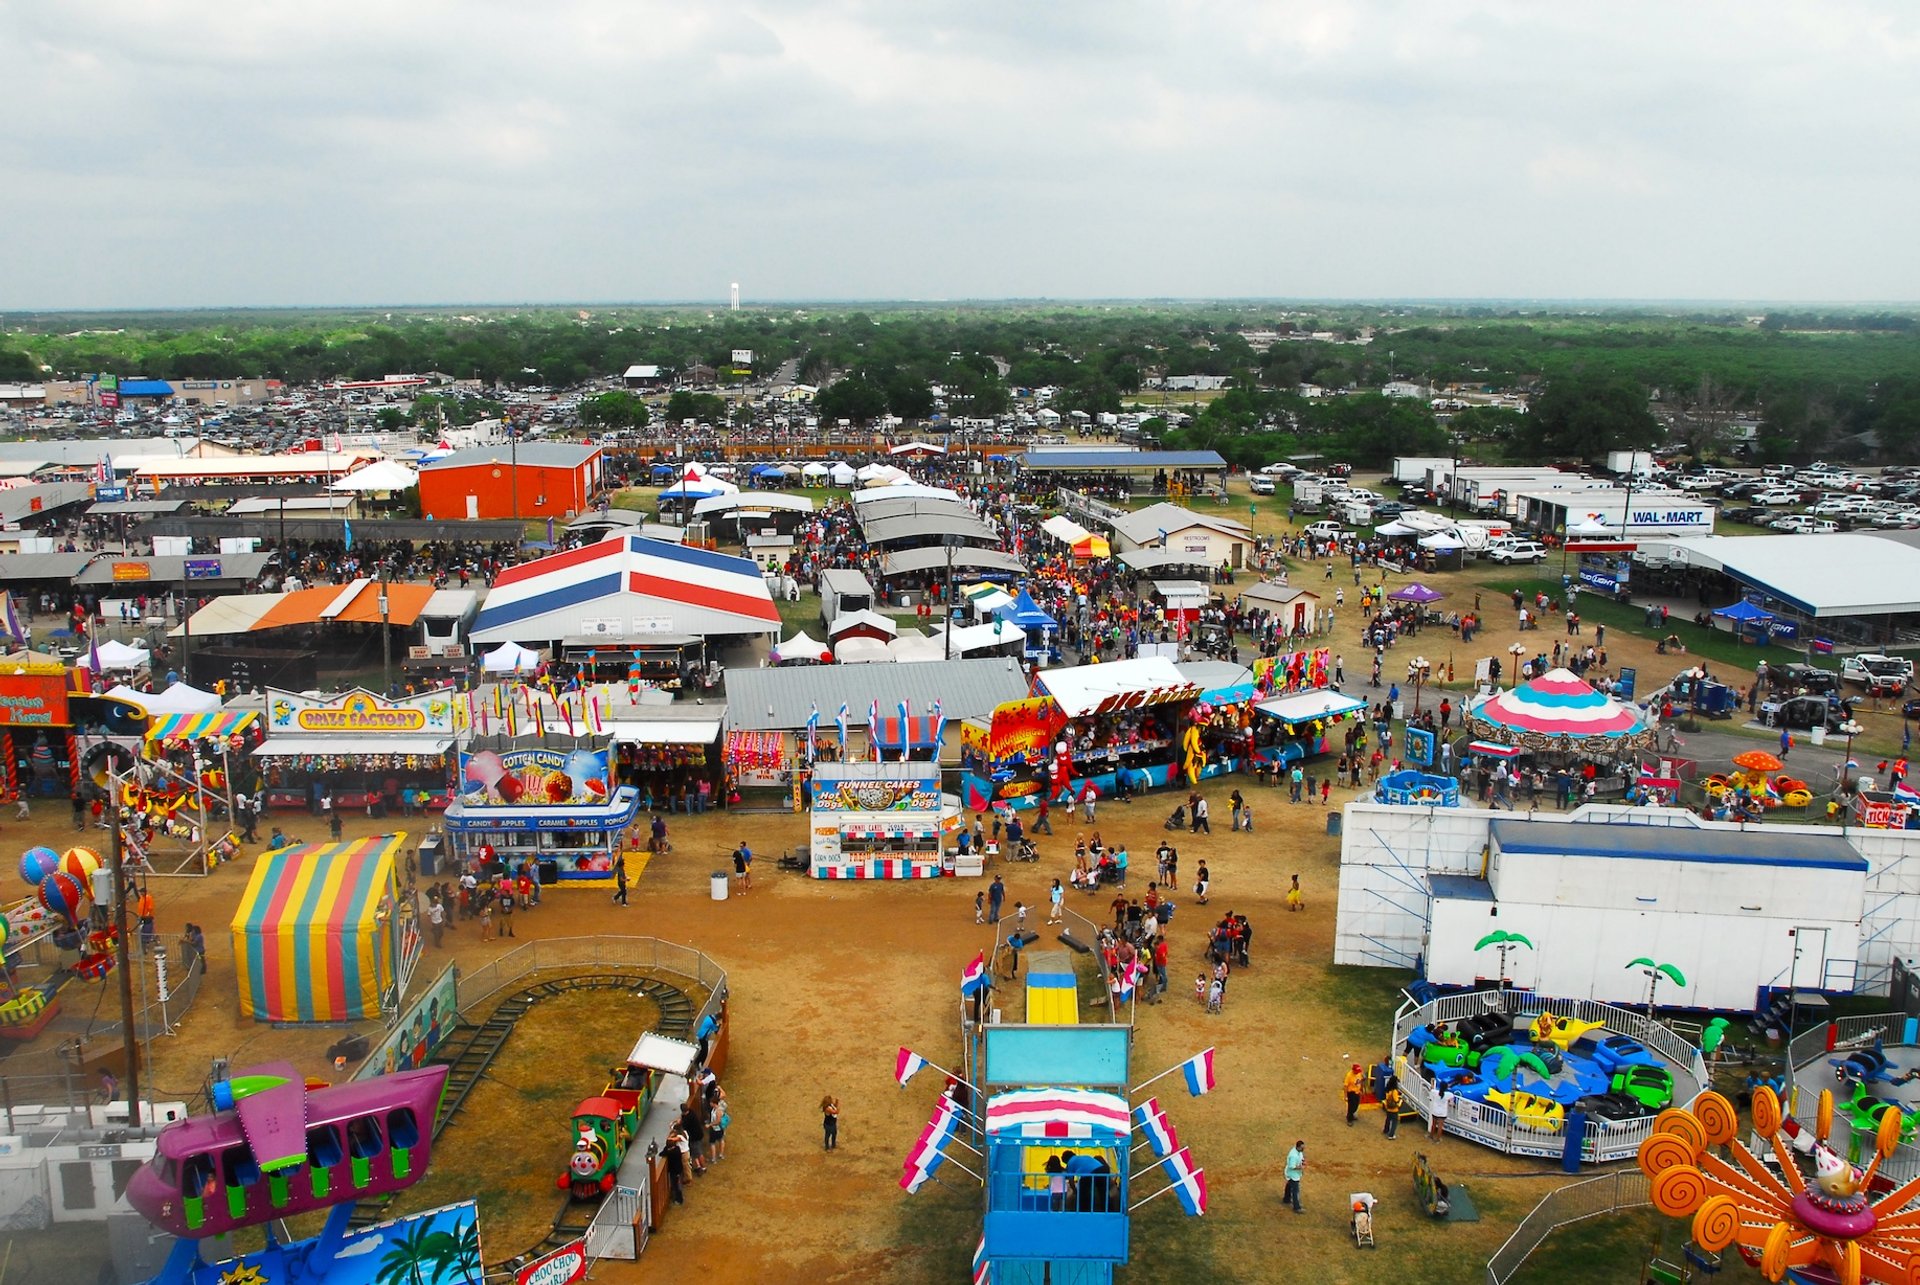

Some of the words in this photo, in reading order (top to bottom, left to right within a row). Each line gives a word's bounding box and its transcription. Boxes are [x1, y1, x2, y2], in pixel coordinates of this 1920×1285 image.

[1580, 571, 1592, 581] BUD
[1593, 575, 1616, 587] LIGHT
[305, 713, 346, 727] PRIZE
[350, 712, 418, 727] FACTORY
[992, 729, 1030, 756] MACHINE
[503, 753, 535, 769] COTTON
[537, 753, 566, 768] CANDY
[836, 781, 882, 790] FUNNEL
[884, 780, 920, 789] CAKES
[911, 791, 938, 799] Corn
[817, 800, 843, 808] Dogs
[911, 800, 938, 808] Dogs
[538, 819, 567, 827] CARAMEL
[574, 818, 599, 827] APPLES
[849, 824, 866, 832] FUNNEL
[868, 824, 883, 832] CAKES
[814, 853, 827, 862] CORN
[828, 853, 841, 862] DOGS
[1464, 1130, 1477, 1139] The
[1478, 1135, 1498, 1147] Whale
[529, 1263, 553, 1285] CHOO
[553, 1252, 577, 1269] CHOO
